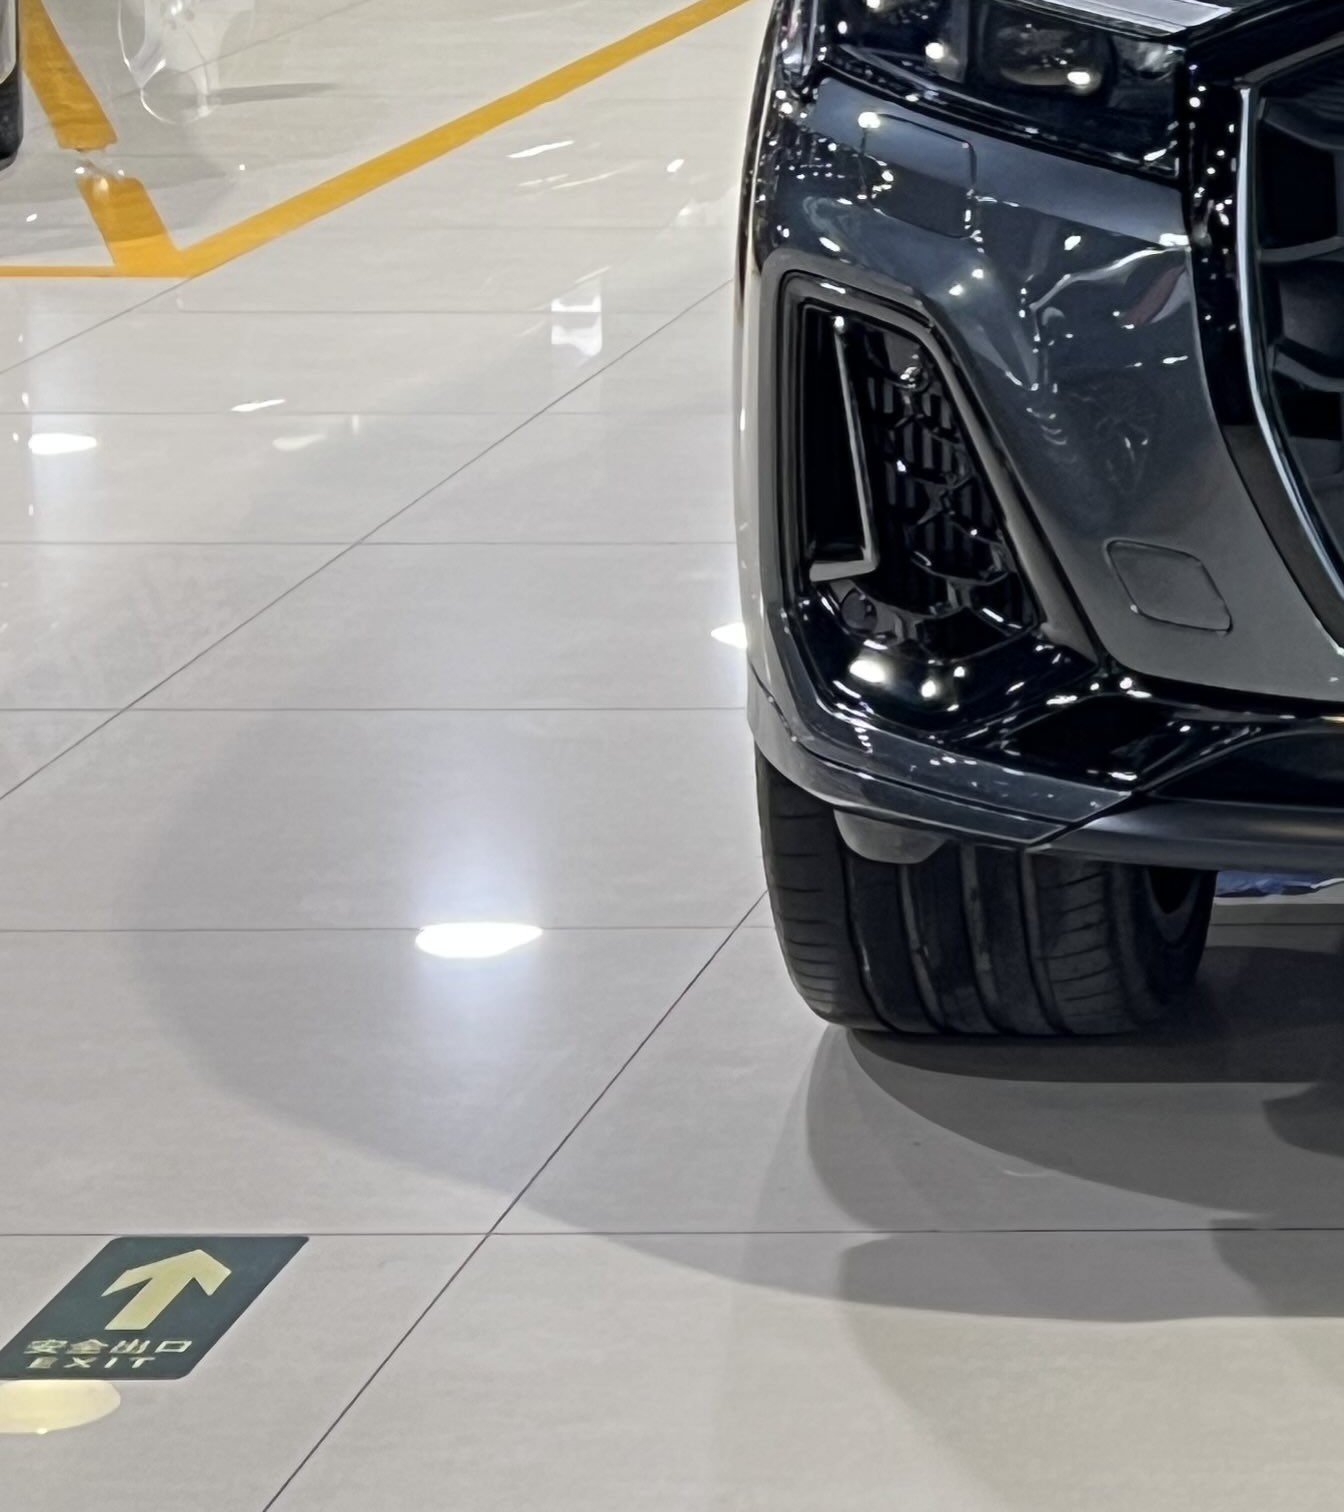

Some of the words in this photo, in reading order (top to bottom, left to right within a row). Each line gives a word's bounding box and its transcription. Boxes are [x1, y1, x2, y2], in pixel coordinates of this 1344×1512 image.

[24, 1338, 193, 1355] 安全出口
[25, 1356, 156, 1369] EXIT
